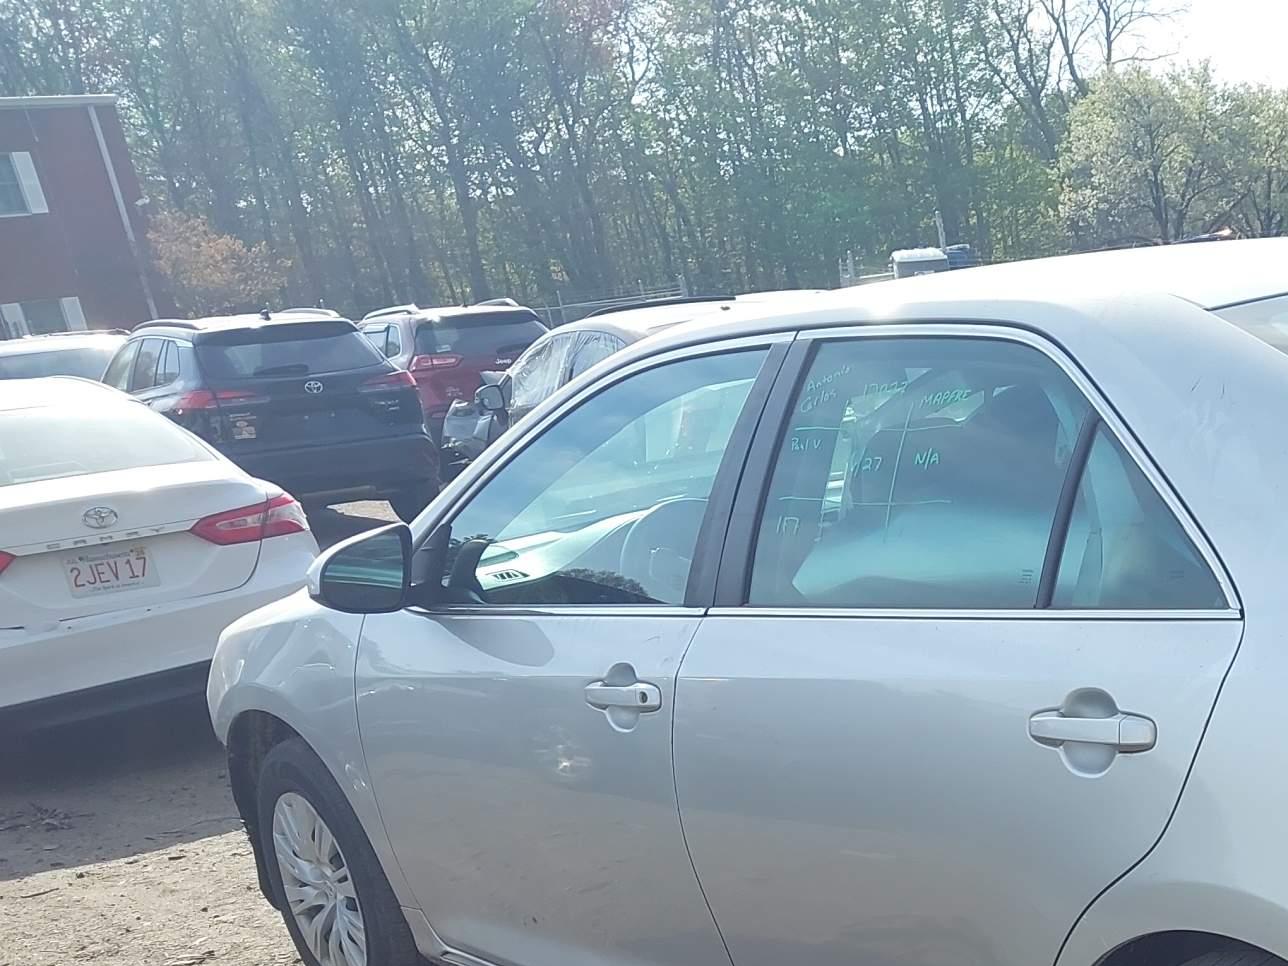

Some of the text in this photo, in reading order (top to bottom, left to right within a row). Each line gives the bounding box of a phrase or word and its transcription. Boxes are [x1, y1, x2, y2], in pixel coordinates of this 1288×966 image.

[800, 389, 838, 413] Carlos
[918, 389, 972, 409] MAPFRE
[914, 448, 940, 470] N/A
[124, 556, 147, 579] 17
